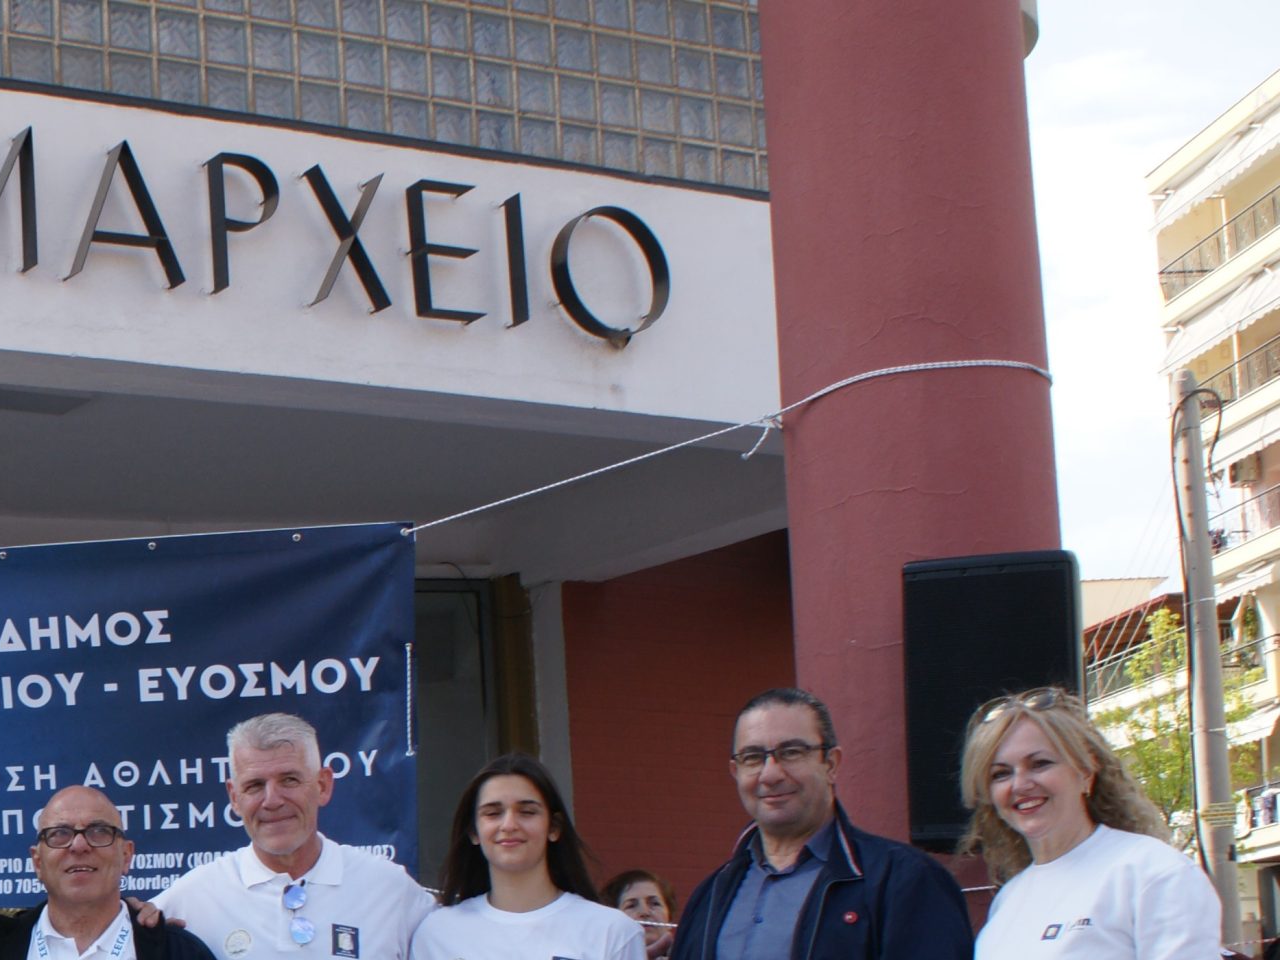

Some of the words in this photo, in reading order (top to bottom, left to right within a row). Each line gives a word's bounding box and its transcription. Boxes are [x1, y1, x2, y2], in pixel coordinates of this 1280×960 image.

[138, 657, 380, 702] ΕΥΟΣΜΟΥ
[83, 750, 378, 788] ΑΘΛΗΤΟΥ
[130, 853, 184, 870] ΥΟΣΜΟΥ
[111, 927, 129, 957] ΣΕΓΑΣ
